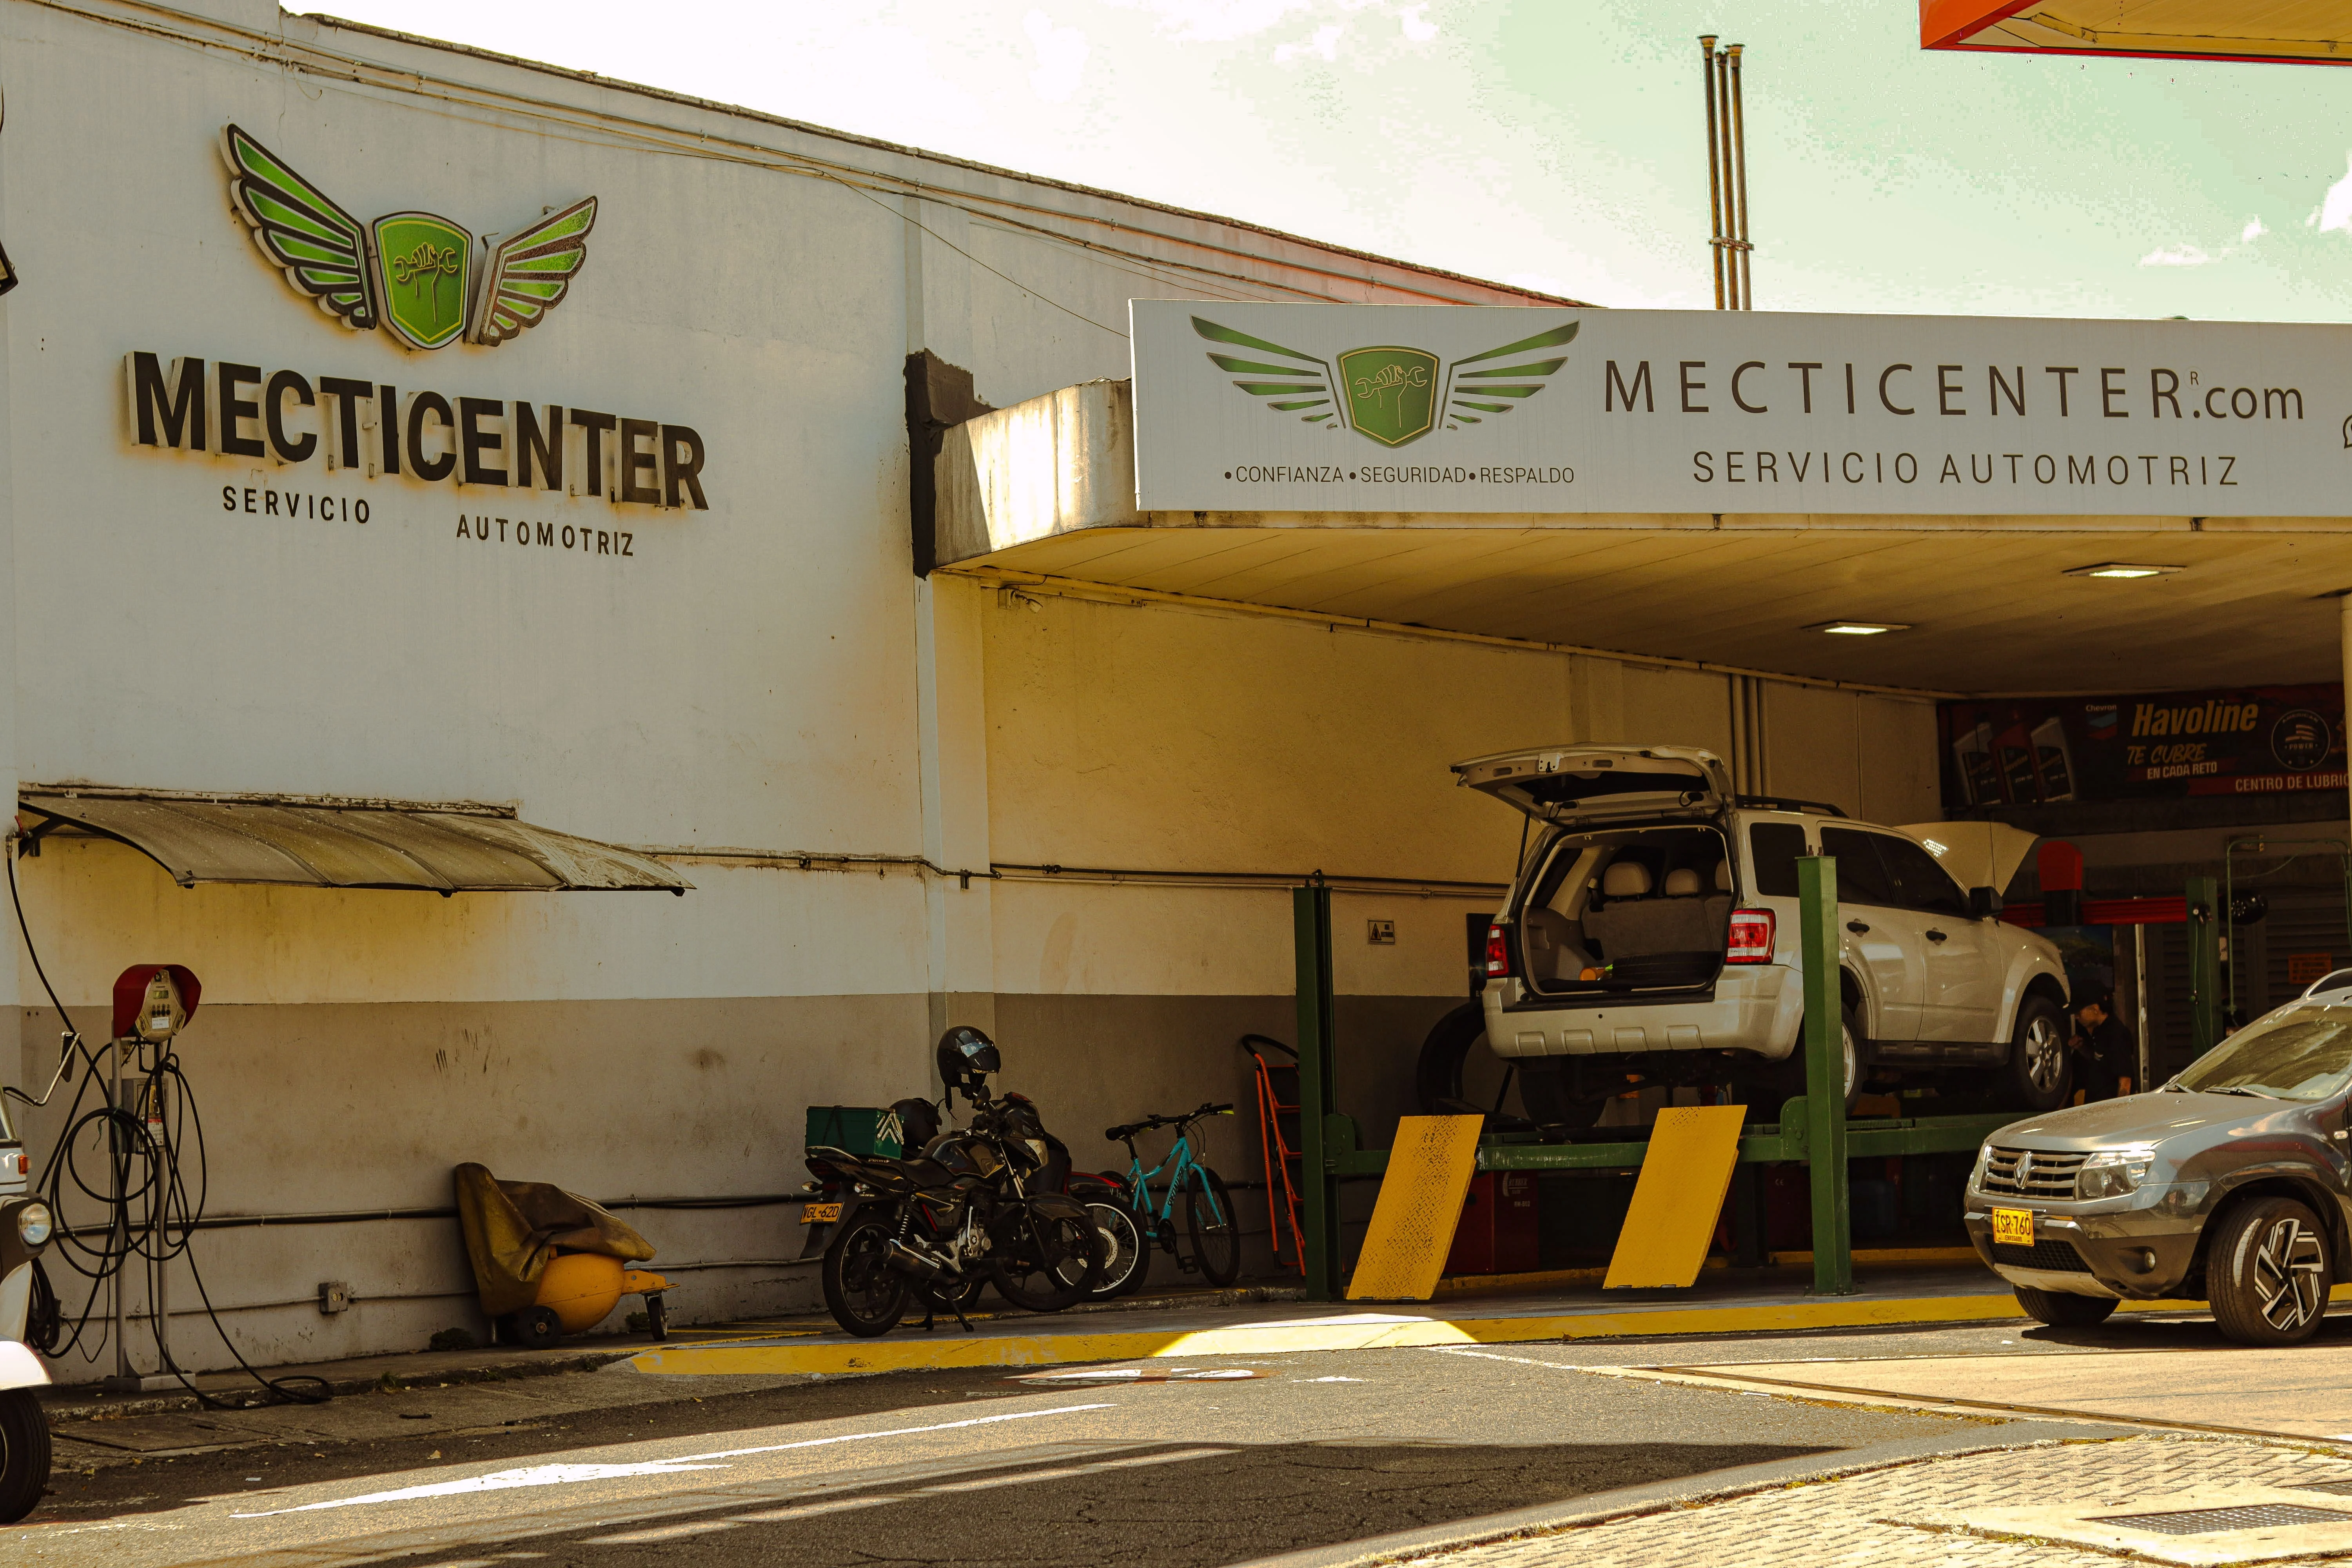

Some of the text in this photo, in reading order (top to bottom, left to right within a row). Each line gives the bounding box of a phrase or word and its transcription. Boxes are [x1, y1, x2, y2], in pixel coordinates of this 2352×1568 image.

[126, 350, 709, 511] MECTICENTER
[1236, 466, 1575, 484] CONFIANZA SEGURIDAD RESPALDO
[1693, 451, 2238, 485] SERVICIO AUTOMOTRIZ
[223, 486, 634, 557] SERVICIO AUTOMOTRIZ
[2086, 704, 2117, 712] Chevron
[2131, 699, 2259, 737] Havoline
[2127, 743, 2208, 765] TE CUBRE
[2147, 761, 2217, 780] EN CADA RETO
[2236, 777, 2283, 792] CENTRO
[2288, 775, 2303, 789] DE
